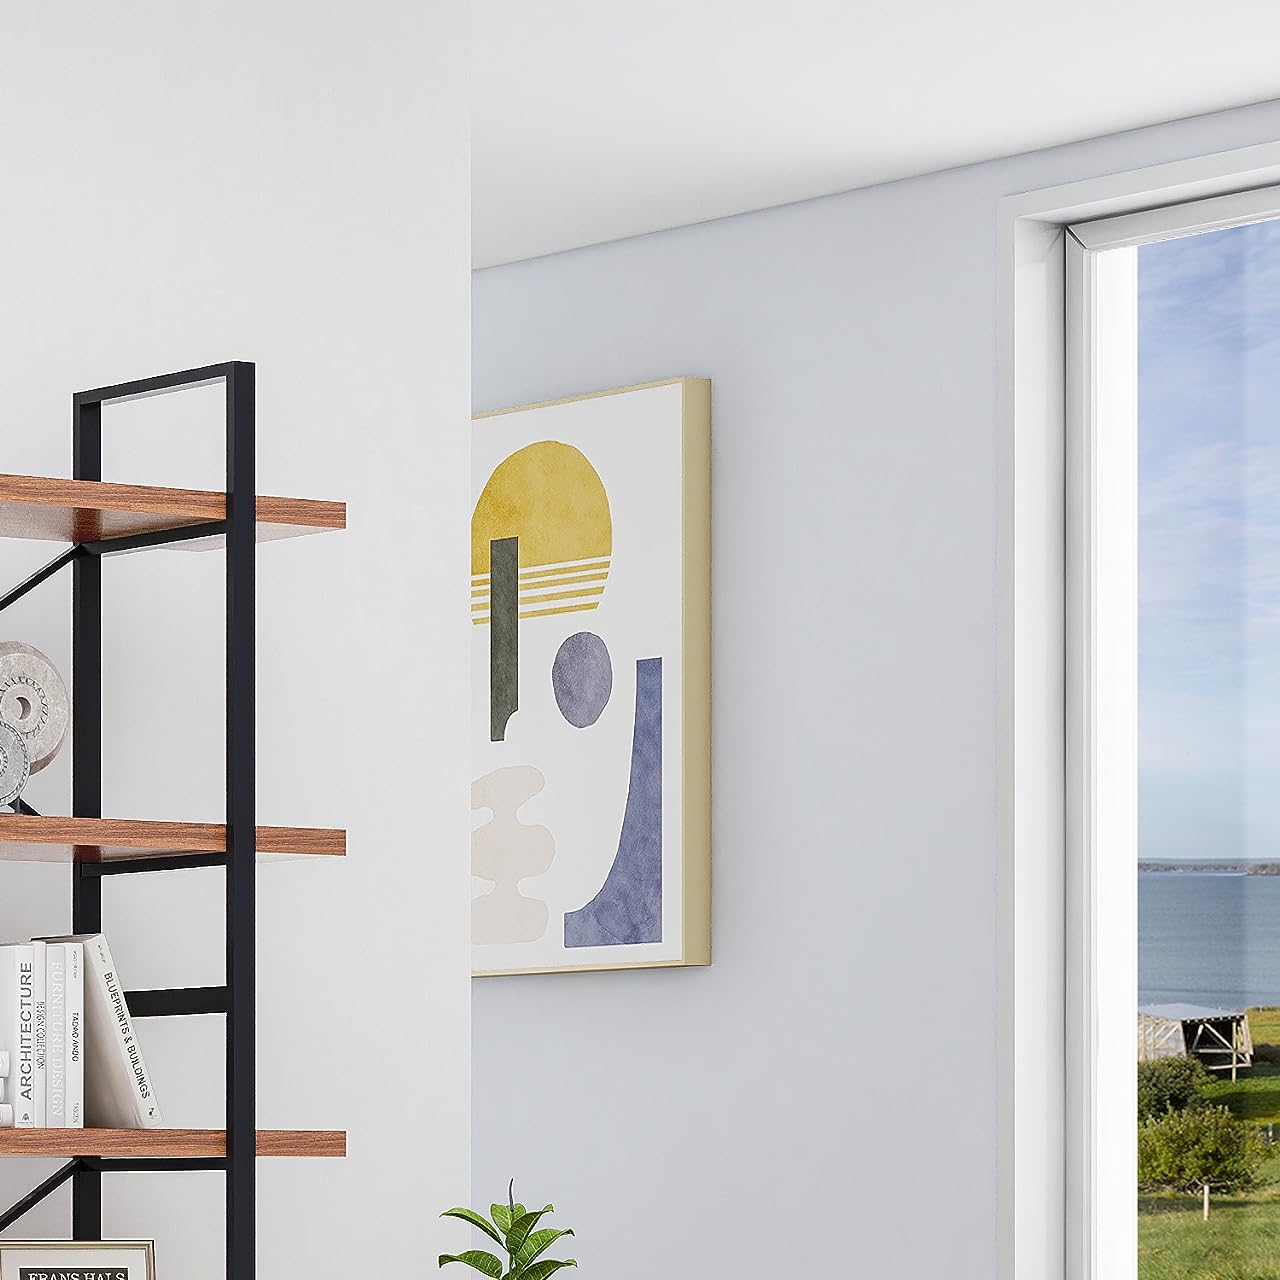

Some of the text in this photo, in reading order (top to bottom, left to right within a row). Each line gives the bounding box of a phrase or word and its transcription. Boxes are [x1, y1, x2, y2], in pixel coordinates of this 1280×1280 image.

[20, 962, 32, 1101] ARCHITECTURE
[35, 1001, 45, 1026] DESIGN
[51, 961, 64, 1117] FURNITURE DESIGN
[72, 1012, 80, 1062] TADAO ANDO
[104, 971, 151, 1100] BLUEPRINTS & BUILDINGS
